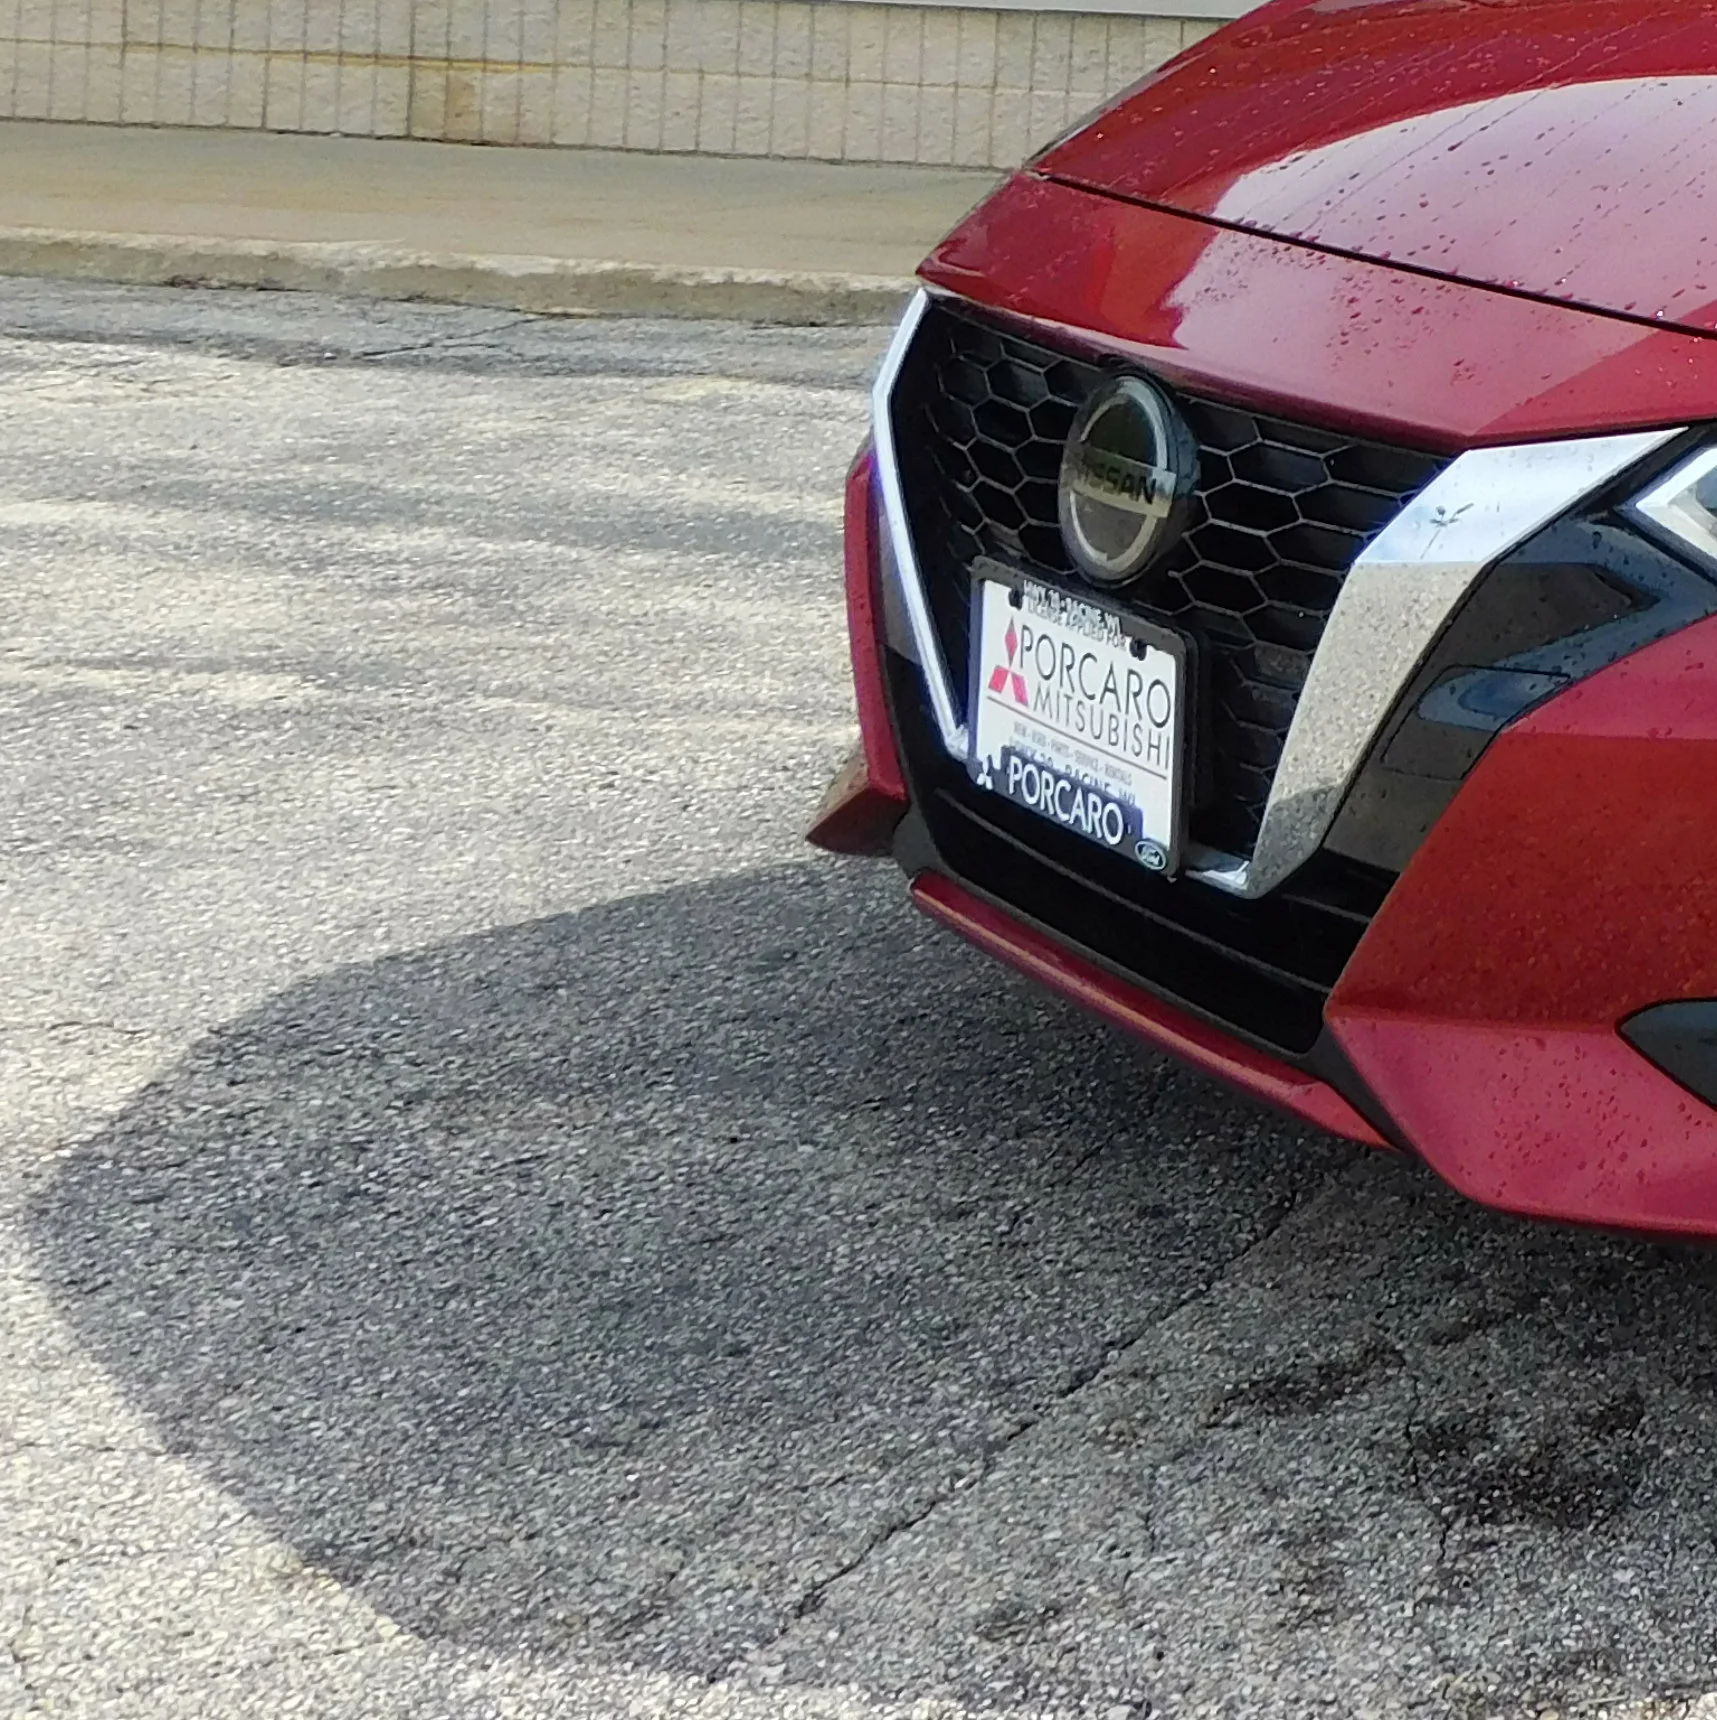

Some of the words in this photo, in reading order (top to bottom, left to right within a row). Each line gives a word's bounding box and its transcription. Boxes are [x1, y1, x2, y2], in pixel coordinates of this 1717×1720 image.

[1018, 625, 1172, 730] PORCARO
[1033, 682, 1171, 771] MITSUBISHI
[1007, 757, 1124, 847] PORCARO
